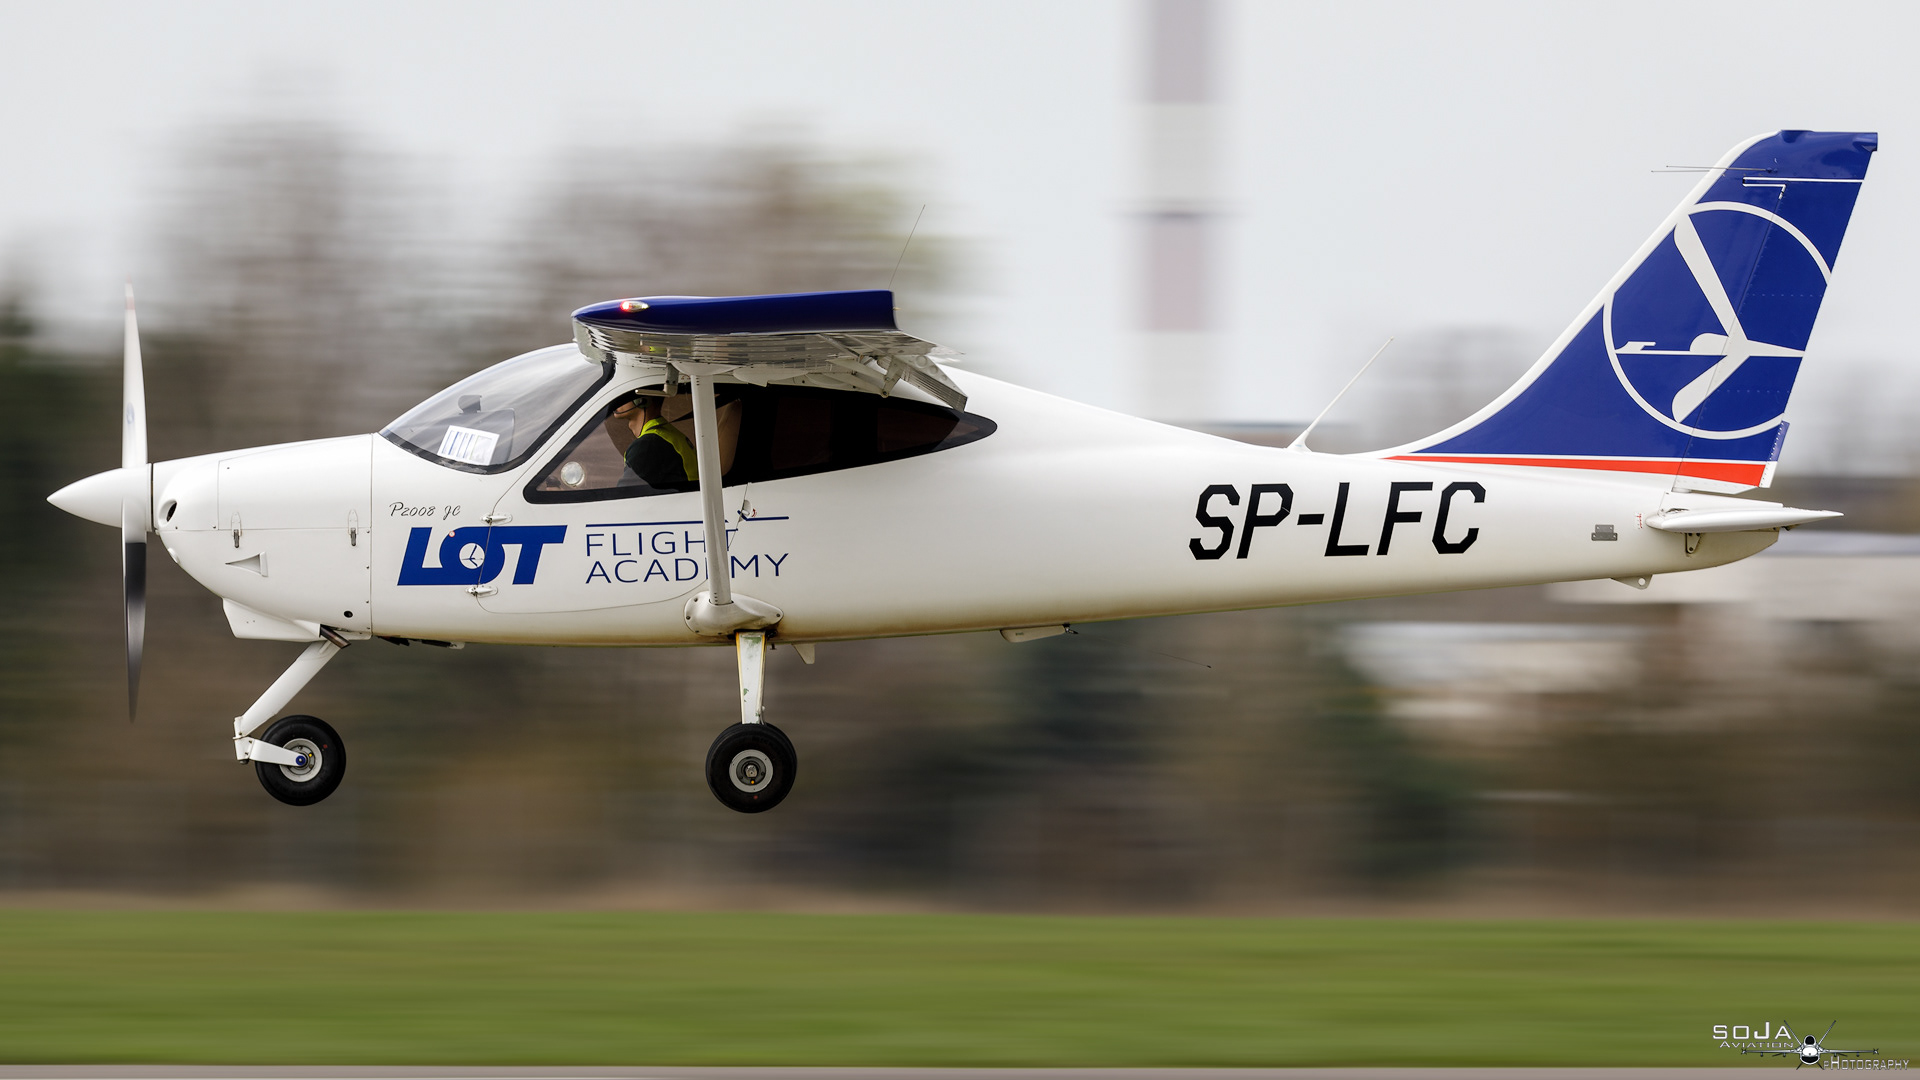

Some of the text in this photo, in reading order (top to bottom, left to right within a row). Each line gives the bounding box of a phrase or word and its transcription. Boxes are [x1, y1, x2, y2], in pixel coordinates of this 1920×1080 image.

[389, 501, 461, 520] P2008 JC
[1188, 482, 1487, 560] SP-LFC
[397, 525, 568, 586] LOT
[585, 528, 738, 556] FLIGHT
